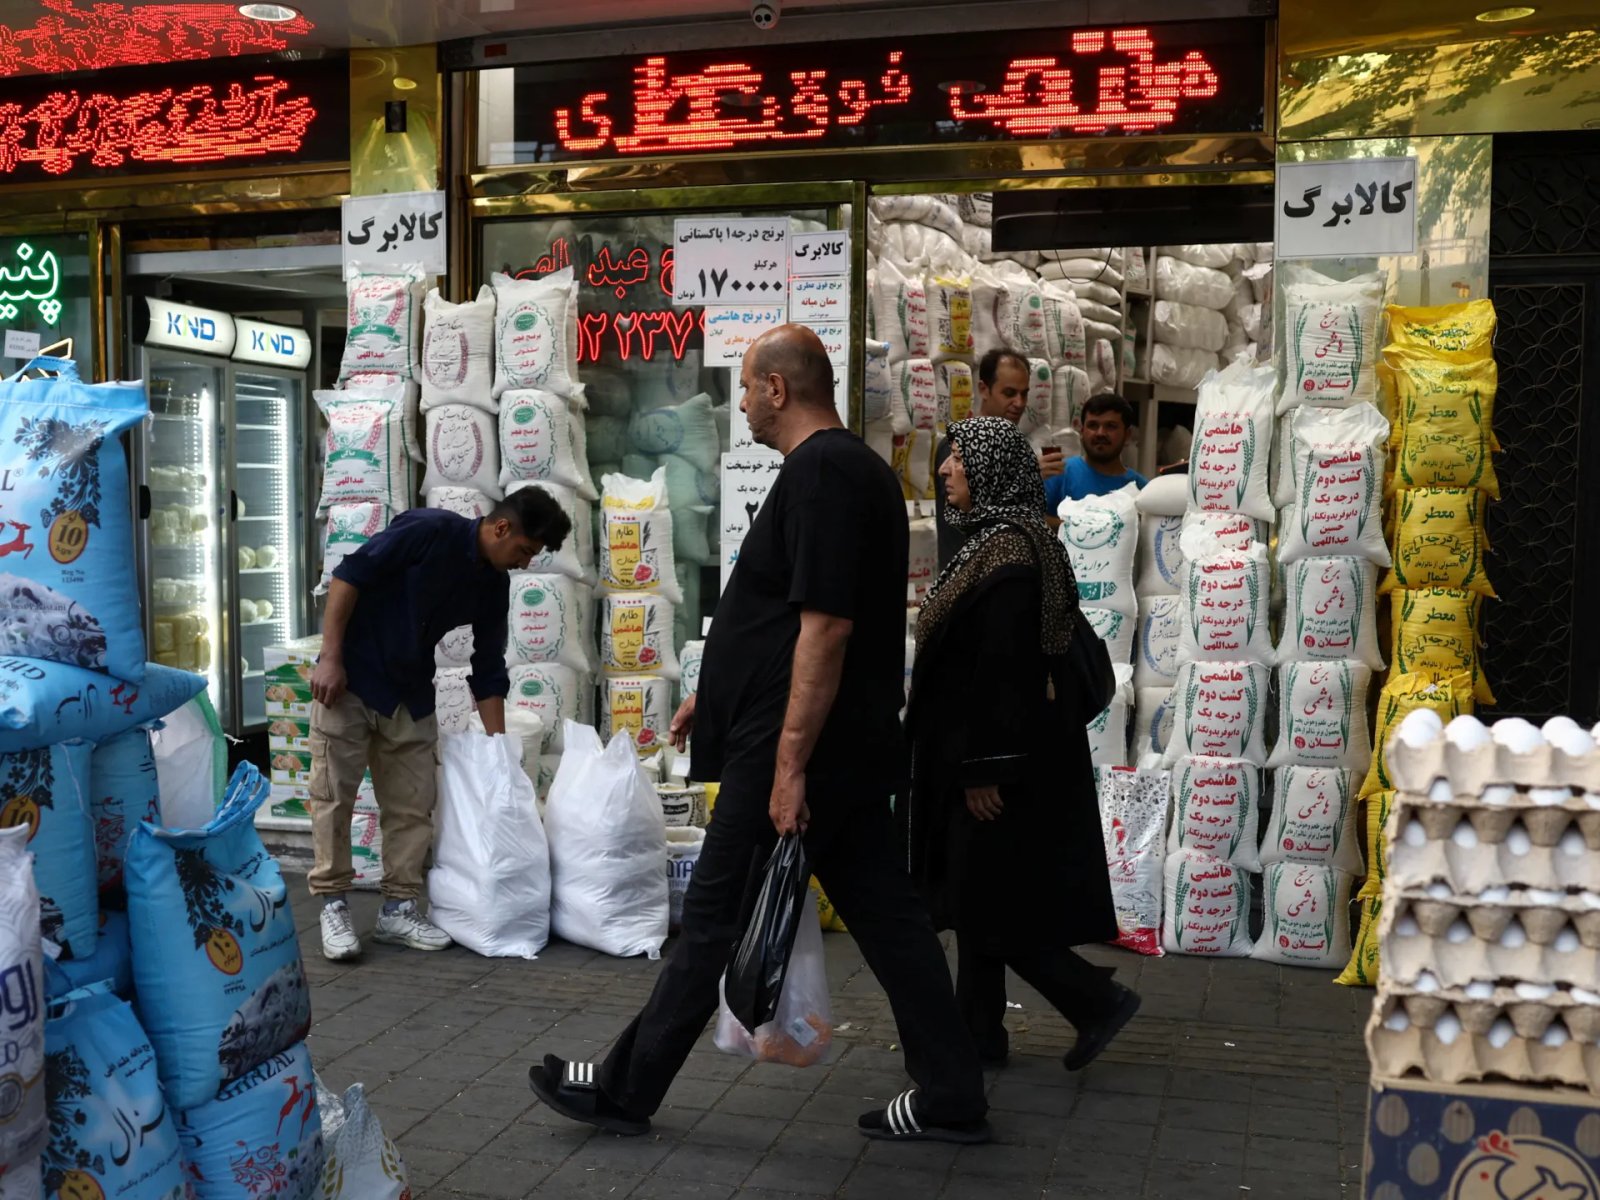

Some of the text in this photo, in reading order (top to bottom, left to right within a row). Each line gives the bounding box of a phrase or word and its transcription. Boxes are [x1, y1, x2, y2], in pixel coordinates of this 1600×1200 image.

[1284, 180, 1413, 227] کالابرگ
[347, 210, 443, 253] کالابرگ
[679, 227, 723, 243] پاکستانی
[762, 226, 785, 242] برنج
[795, 241, 844, 261] کالابرگ
[698, 268, 783, 298] ۱۷۰۰۰۰
[1426, 405, 1458, 422] معطر
[1205, 422, 1242, 437] هاشمی
[1201, 442, 1241, 456] کشت دوم
[1319, 450, 1361, 468] هاشمی
[1200, 461, 1236, 474] درجه یک
[1317, 469, 1362, 488] کشت دوم
[1315, 491, 1359, 505] درجه یک
[1422, 506, 1455, 524] معطر
[1428, 535, 1452, 545] درجه
[1202, 560, 1244, 573] هاشمی
[1201, 577, 1244, 592] کشت دوم
[1420, 572, 1449, 585] شمال
[1201, 598, 1243, 611] درجه یک
[1424, 606, 1456, 623] معطر
[1430, 636, 1455, 646] درجه
[1200, 669, 1243, 682] هاشمی
[1198, 689, 1243, 702] کشت دوم
[1198, 708, 1241, 723] درجه یک
[1194, 773, 1237, 787] هاشمی
[1192, 794, 1236, 807] کشت دوم
[1190, 812, 1232, 827] درجه یک
[1190, 865, 1231, 882] هاشمی
[1190, 883, 1233, 901] کشت دوم
[1189, 905, 1232, 917] درجه یک
